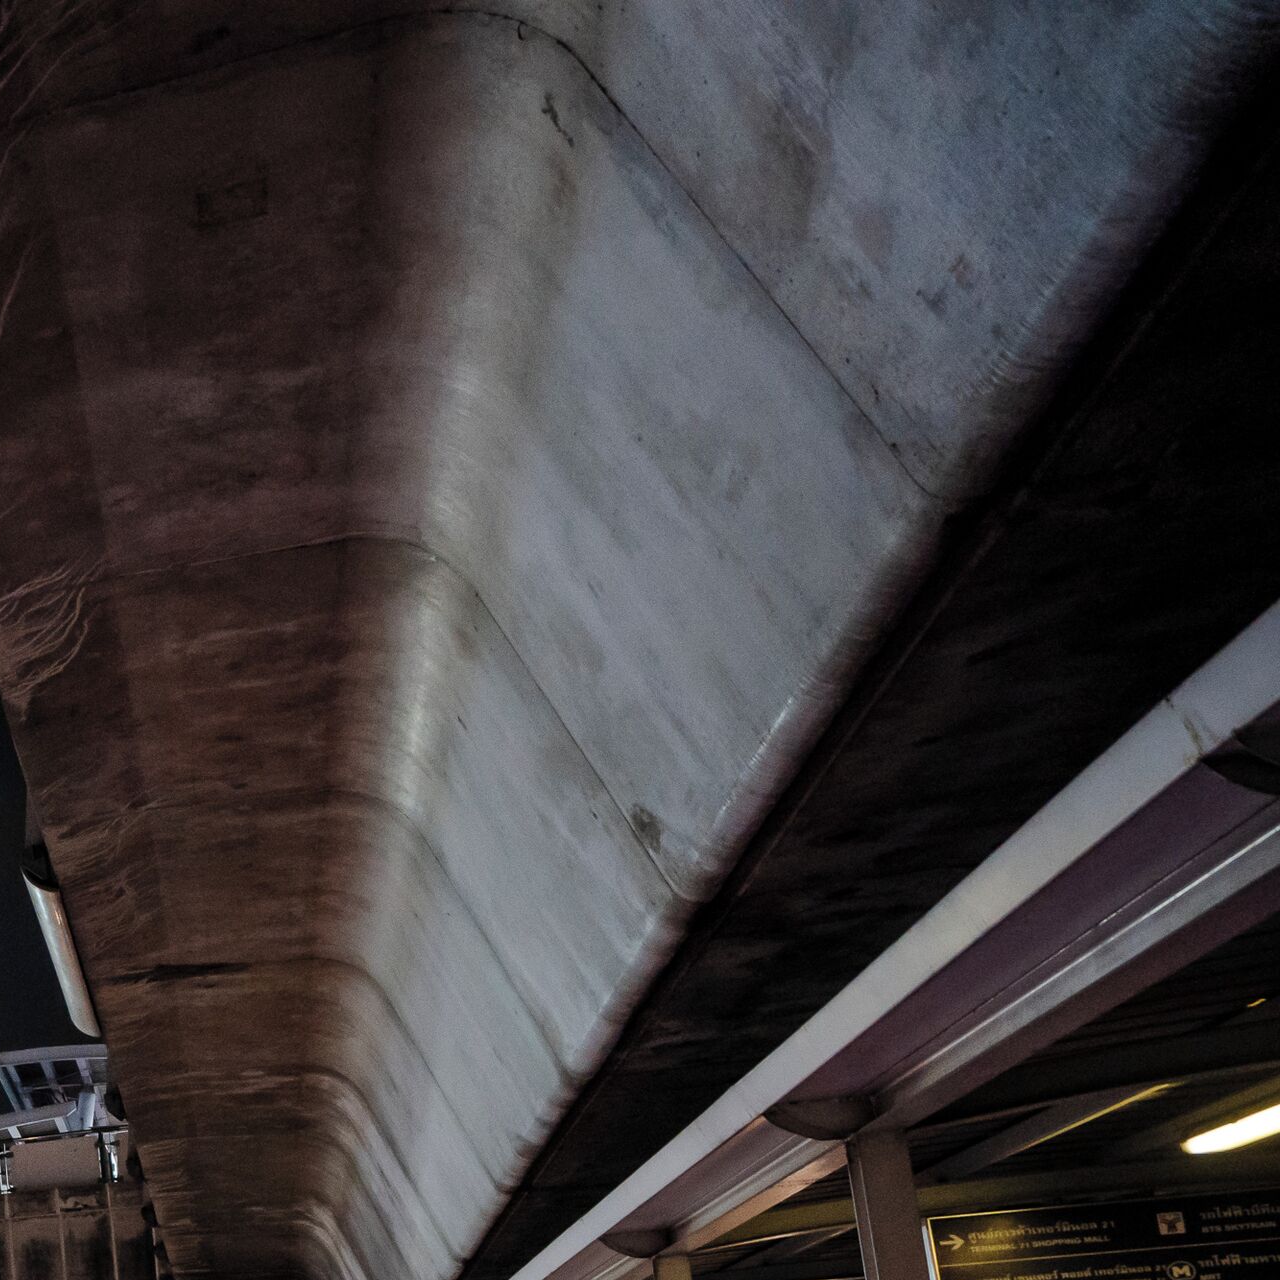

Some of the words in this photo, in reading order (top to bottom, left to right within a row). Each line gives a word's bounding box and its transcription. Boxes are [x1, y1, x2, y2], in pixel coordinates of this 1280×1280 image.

[970, 1243, 1016, 1253] TERMINAL
[1032, 1237, 1082, 1248] SHOPPING
[1083, 1235, 1111, 1243] MALL
